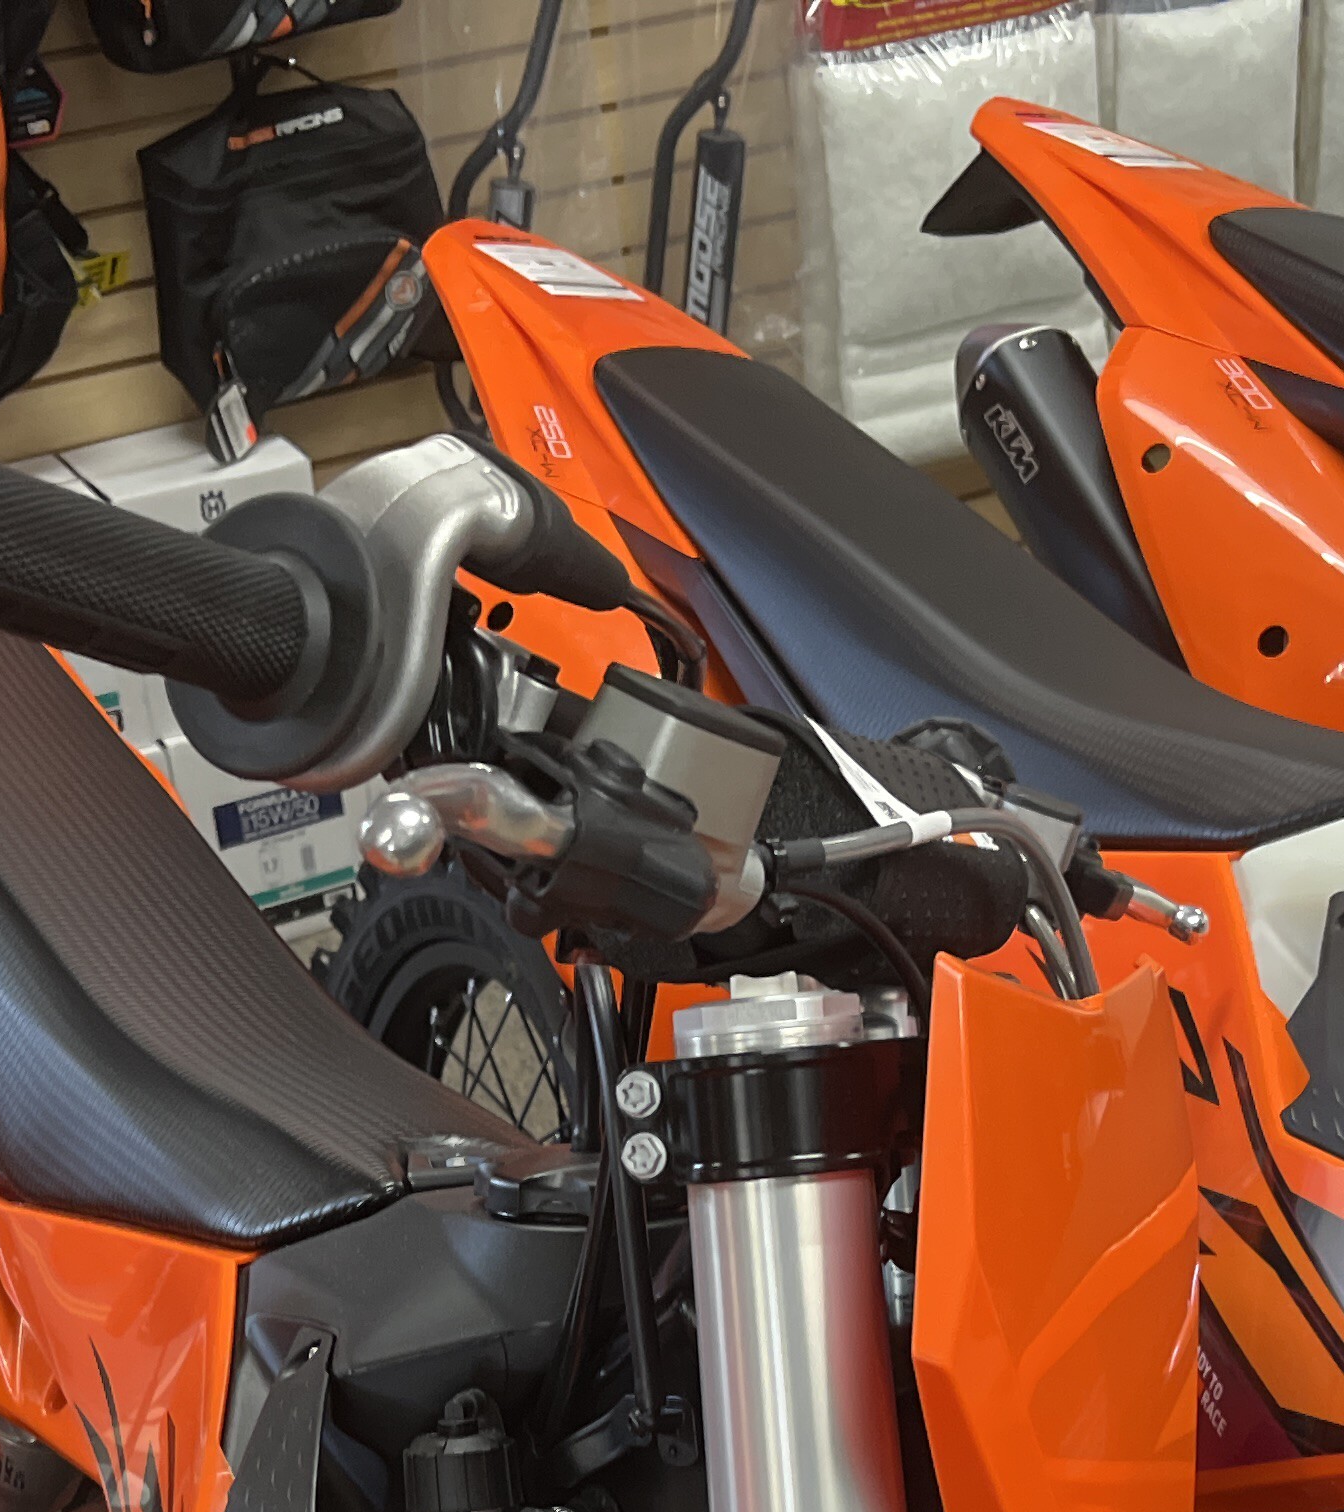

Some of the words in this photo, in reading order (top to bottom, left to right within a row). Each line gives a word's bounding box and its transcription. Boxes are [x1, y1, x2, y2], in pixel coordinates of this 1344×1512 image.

[1214, 358, 1273, 410] 300
[532, 405, 573, 459] 250
[983, 403, 1039, 486] KTM
[1201, 1390, 1228, 1437] RACE
